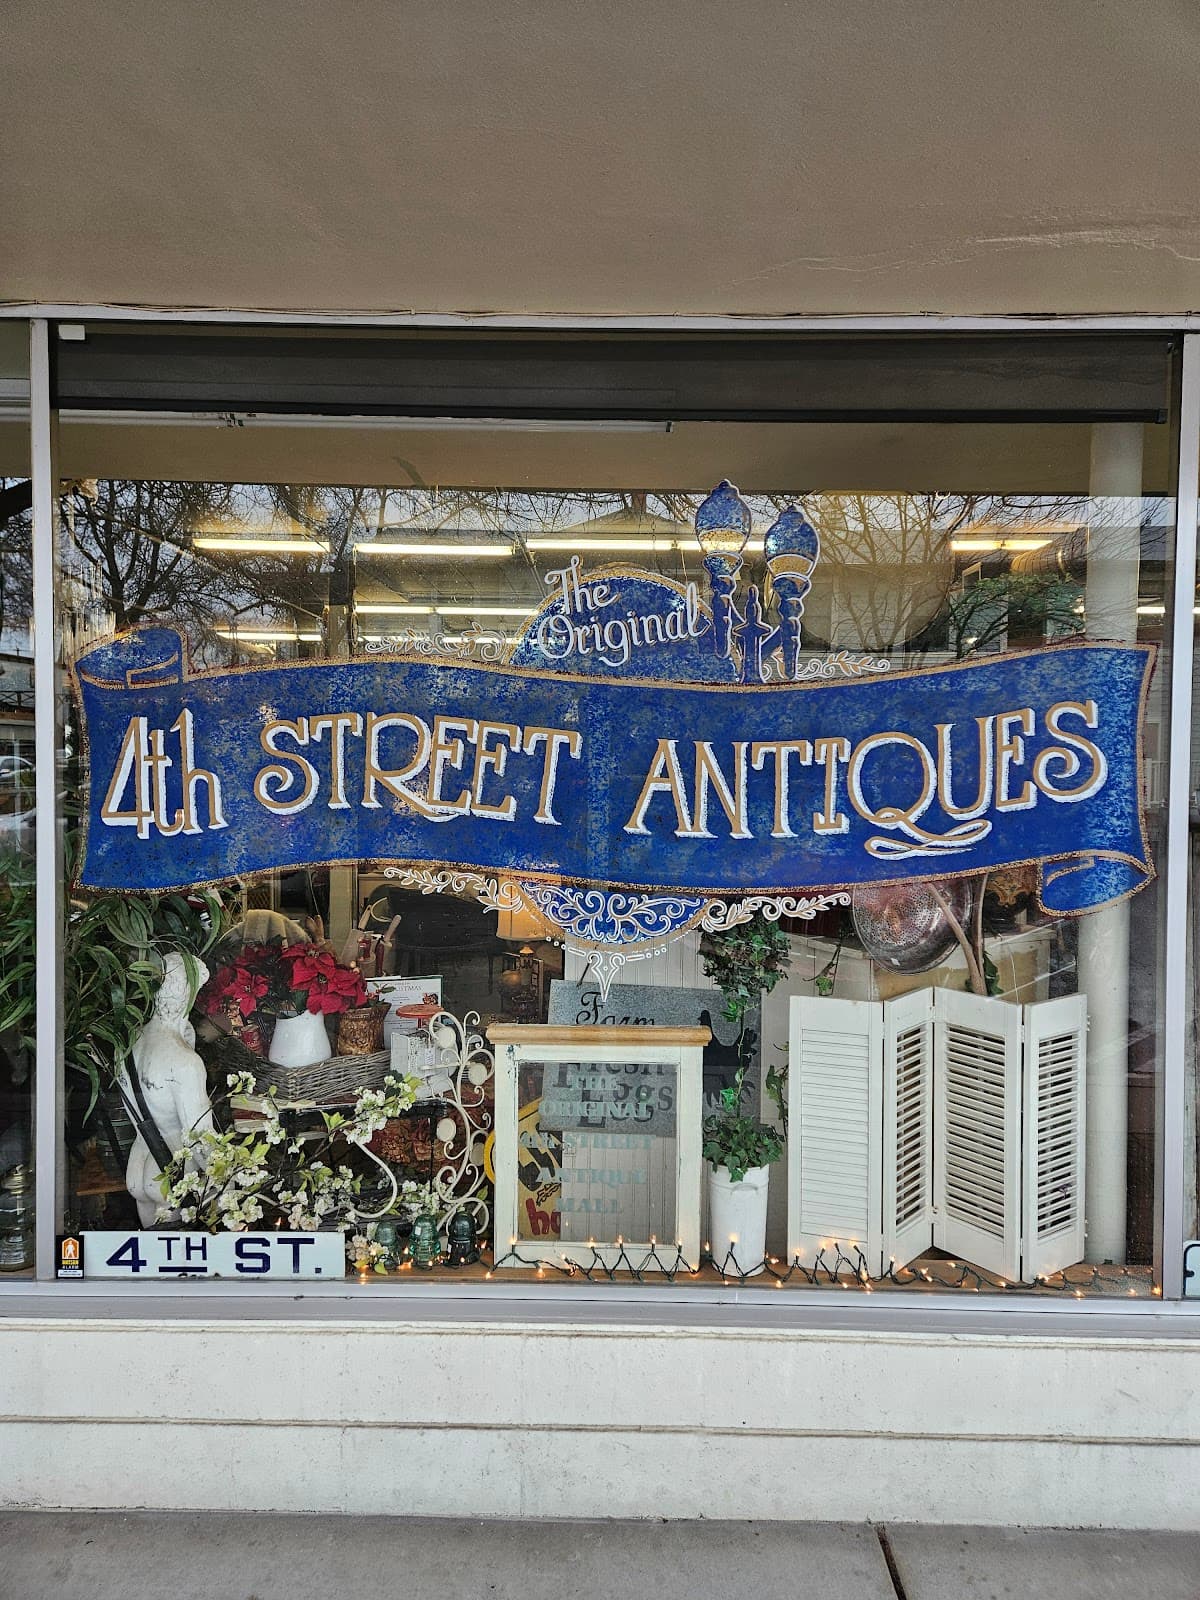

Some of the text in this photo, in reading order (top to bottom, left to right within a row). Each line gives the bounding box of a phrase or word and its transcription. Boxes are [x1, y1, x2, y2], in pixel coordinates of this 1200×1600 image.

[544, 555, 622, 615] The
[537, 582, 712, 667] Original
[101, 699, 1109, 860] 4th STREET ANTIQUES
[540, 1101, 652, 1118] ORIGINAL
[106, 1237, 322, 1274] 4TH ST.
